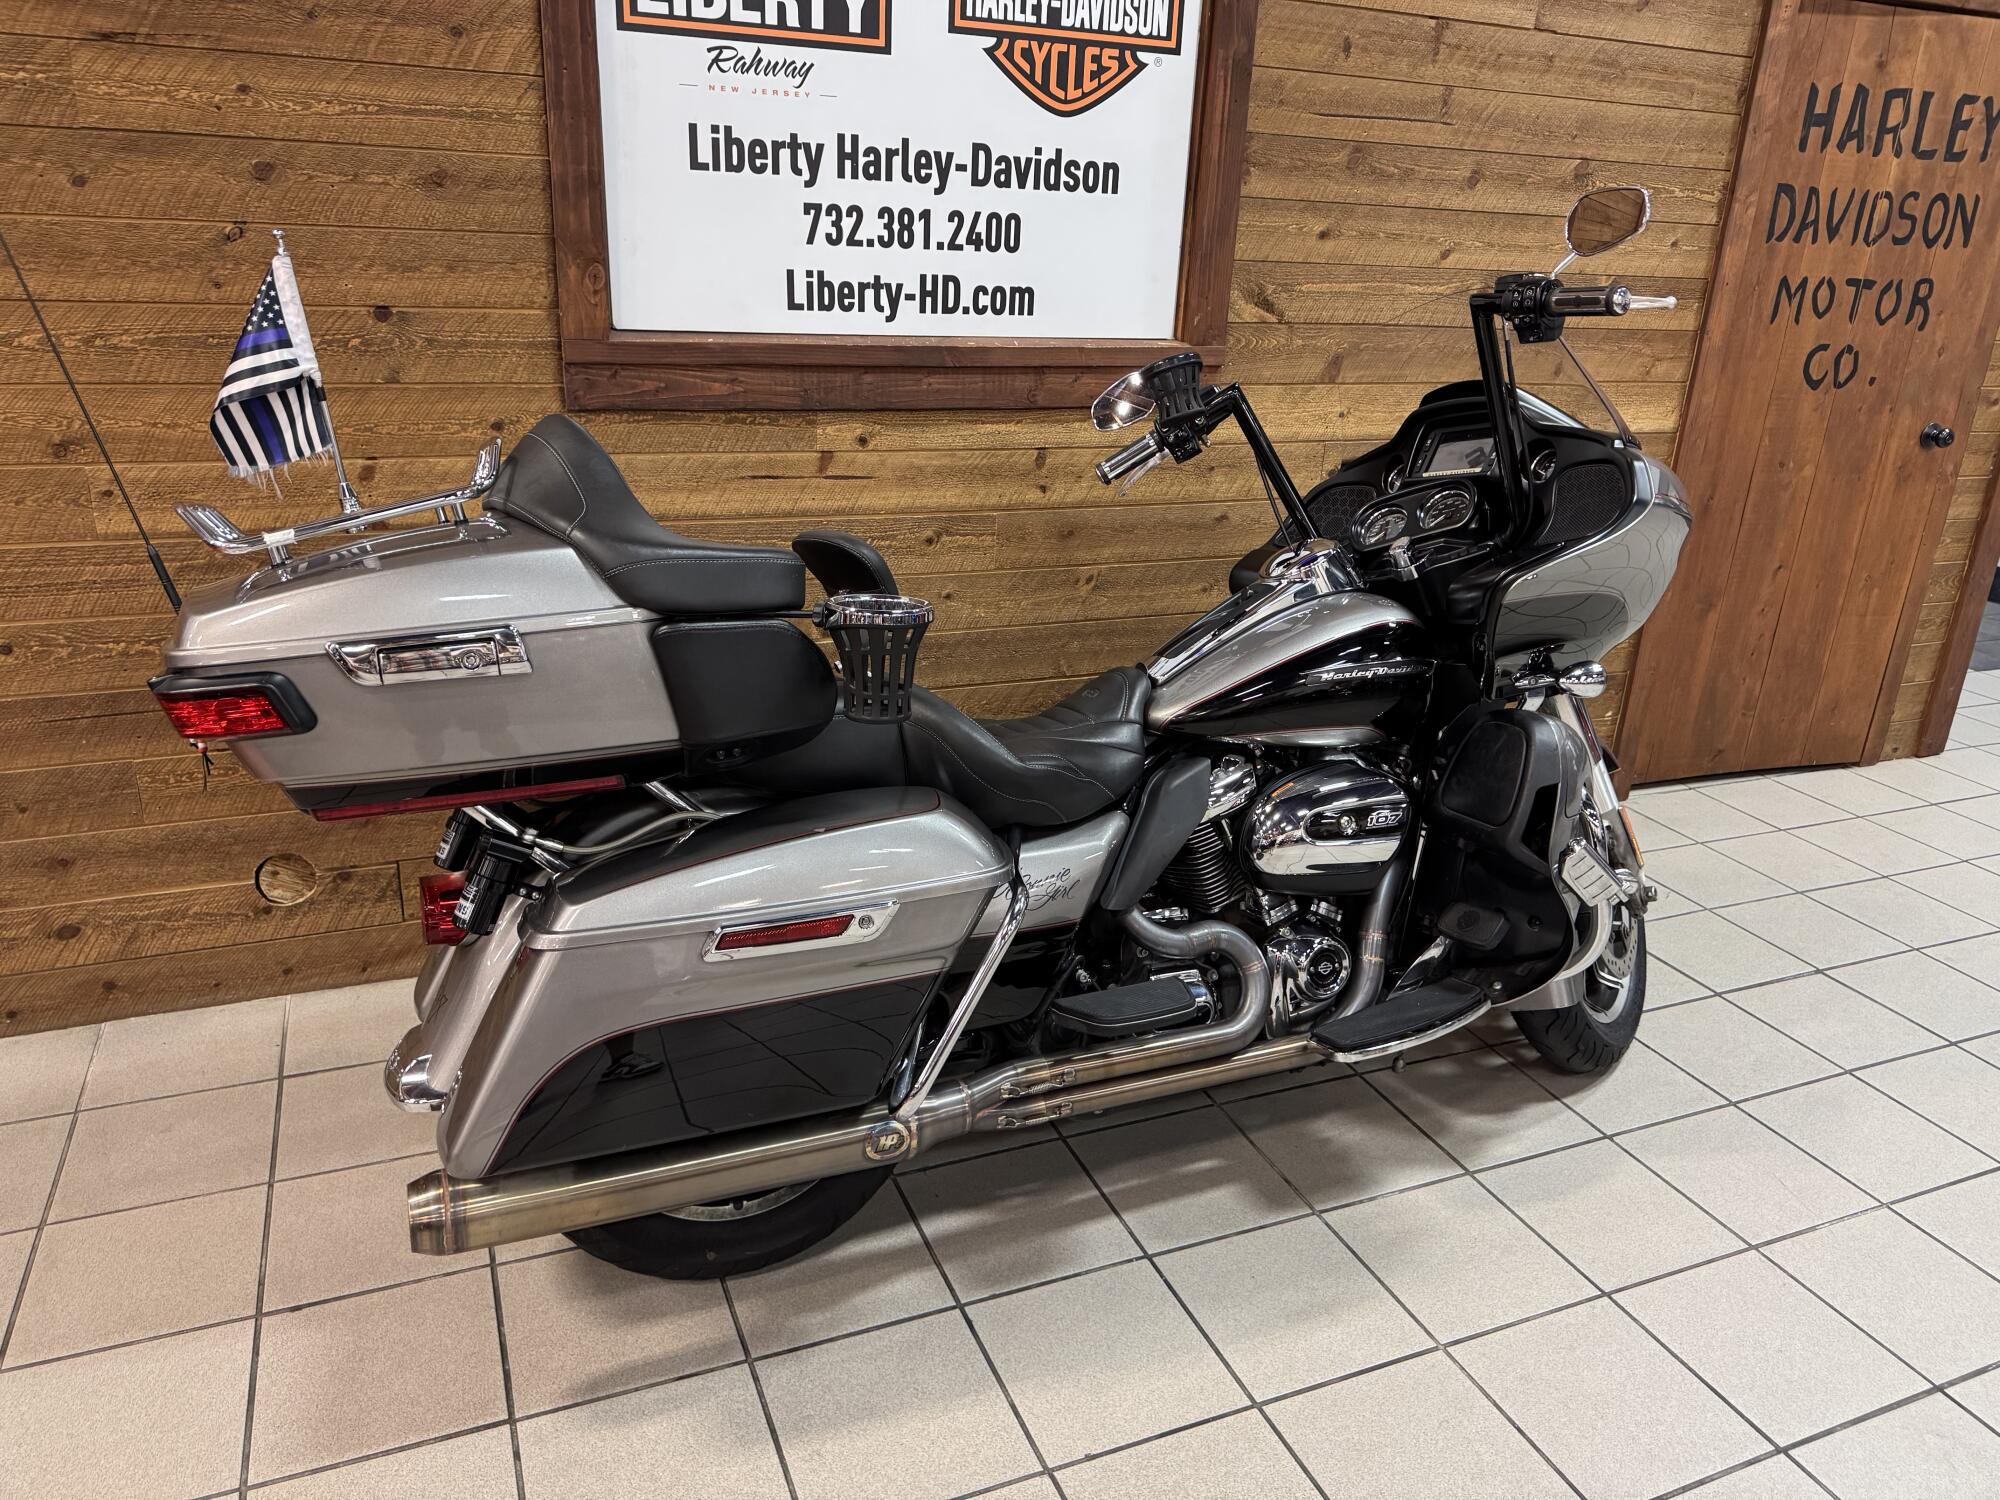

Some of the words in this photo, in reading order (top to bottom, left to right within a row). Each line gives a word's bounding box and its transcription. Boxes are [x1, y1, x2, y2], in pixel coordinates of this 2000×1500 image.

[706, 45, 815, 89] Rahway
[708, 84, 740, 93] NEW
[751, 88, 811, 98] JERSEY
[1013, 39, 1120, 100] CYCLES
[1798, 81, 2000, 162] HARLEY
[687, 122, 825, 188] Liberty
[836, 133, 1120, 196] Harley-Davidson
[803, 202, 1022, 253] 732.381.2400
[1766, 183, 1980, 250] DAVIDSON
[785, 269, 1035, 322] Liberty-HD.com
[1770, 275, 1934, 332] MOTOR
[1803, 344, 1877, 391] CO.
[1367, 810, 1403, 827] 107
